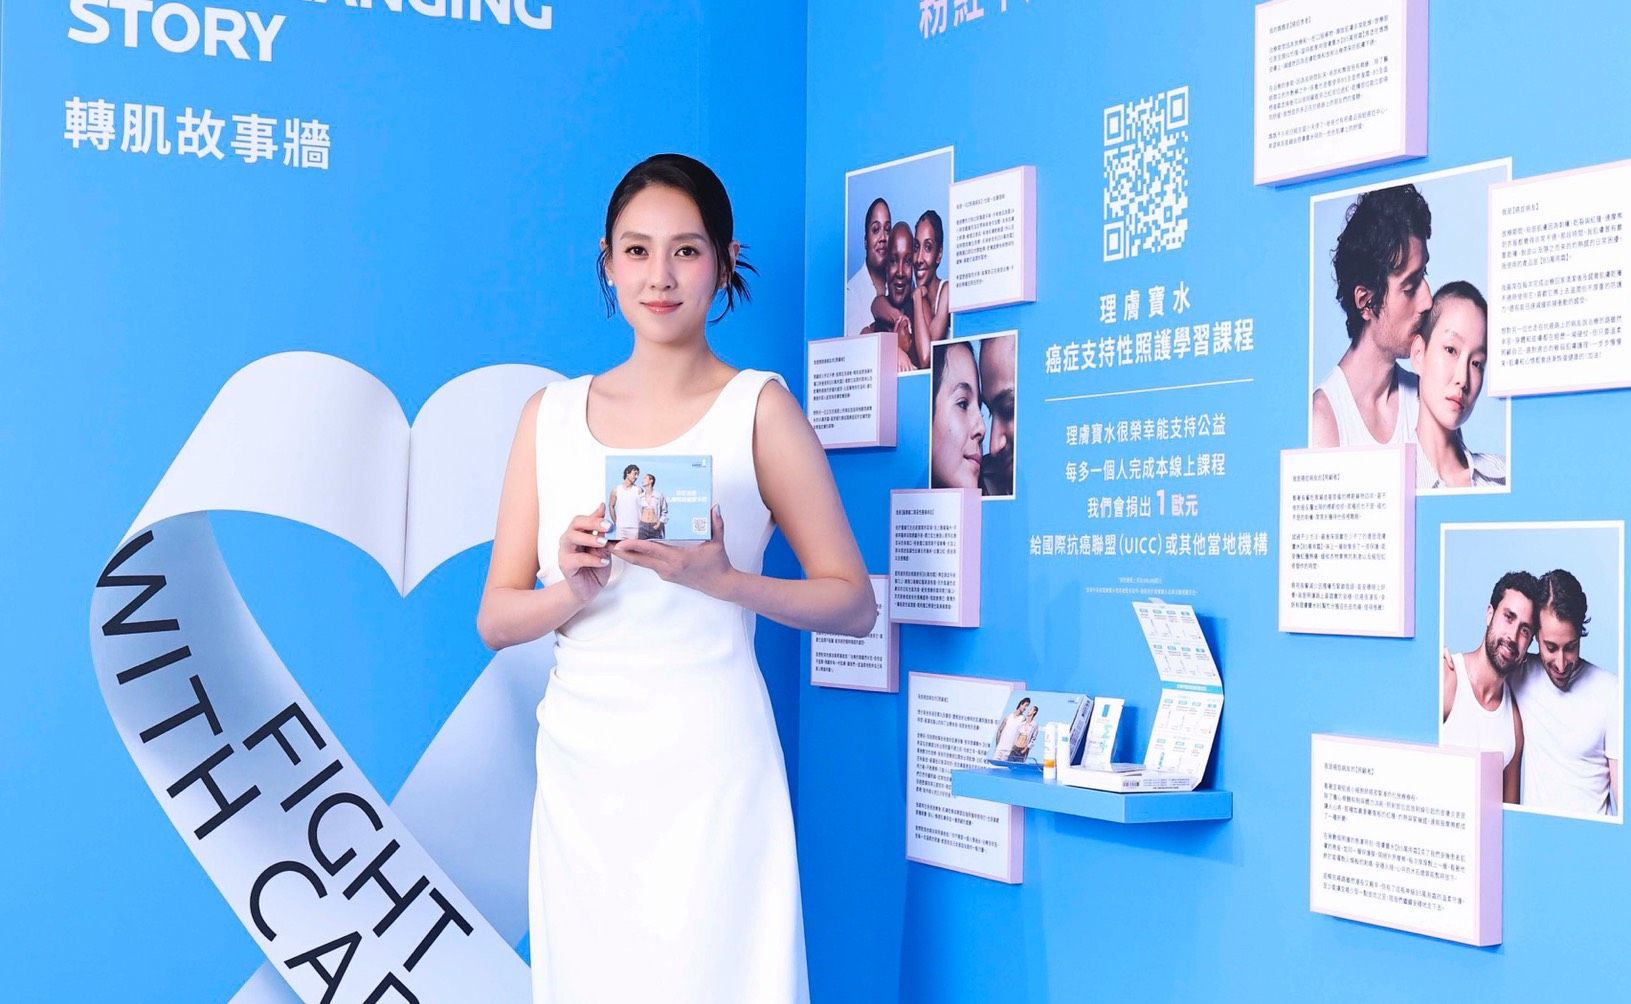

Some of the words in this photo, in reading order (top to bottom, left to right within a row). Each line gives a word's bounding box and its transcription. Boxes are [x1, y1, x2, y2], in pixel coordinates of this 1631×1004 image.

[68, 0, 286, 62] STORY
[63, 97, 331, 170] 轉肌故事牆
[1100, 281, 1191, 324] 理膚寶水
[1045, 318, 1254, 374] 癌症支持性照護學習課程
[1066, 413, 1226, 446] 理膚寶水很榮幸能支持公益
[1065, 453, 1226, 483] 每多一個人完成本線上課程
[96, 530, 262, 840] WITH
[242, 702, 474, 972] FIGHT
